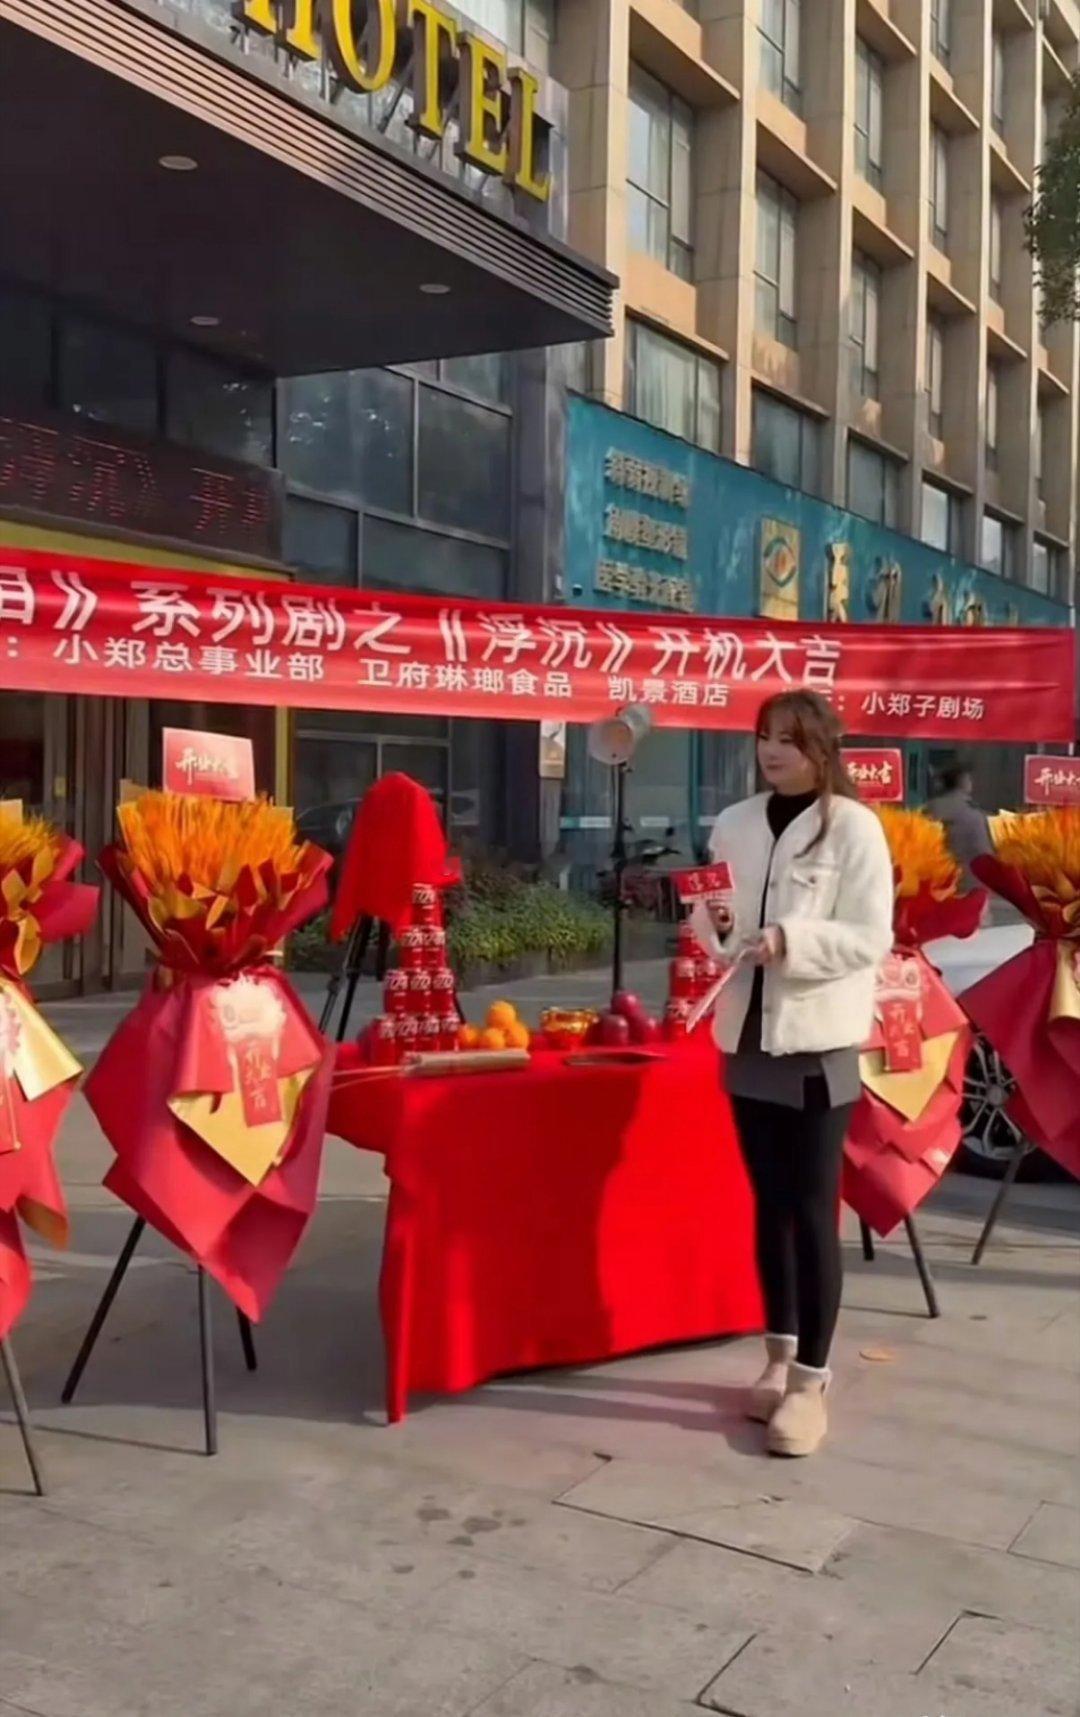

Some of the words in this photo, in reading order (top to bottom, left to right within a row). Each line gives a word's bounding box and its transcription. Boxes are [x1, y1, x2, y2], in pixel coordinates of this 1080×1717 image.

[607, 676, 729, 708] 凯景酒店
[1033, 766, 1080, 796] 开业大
